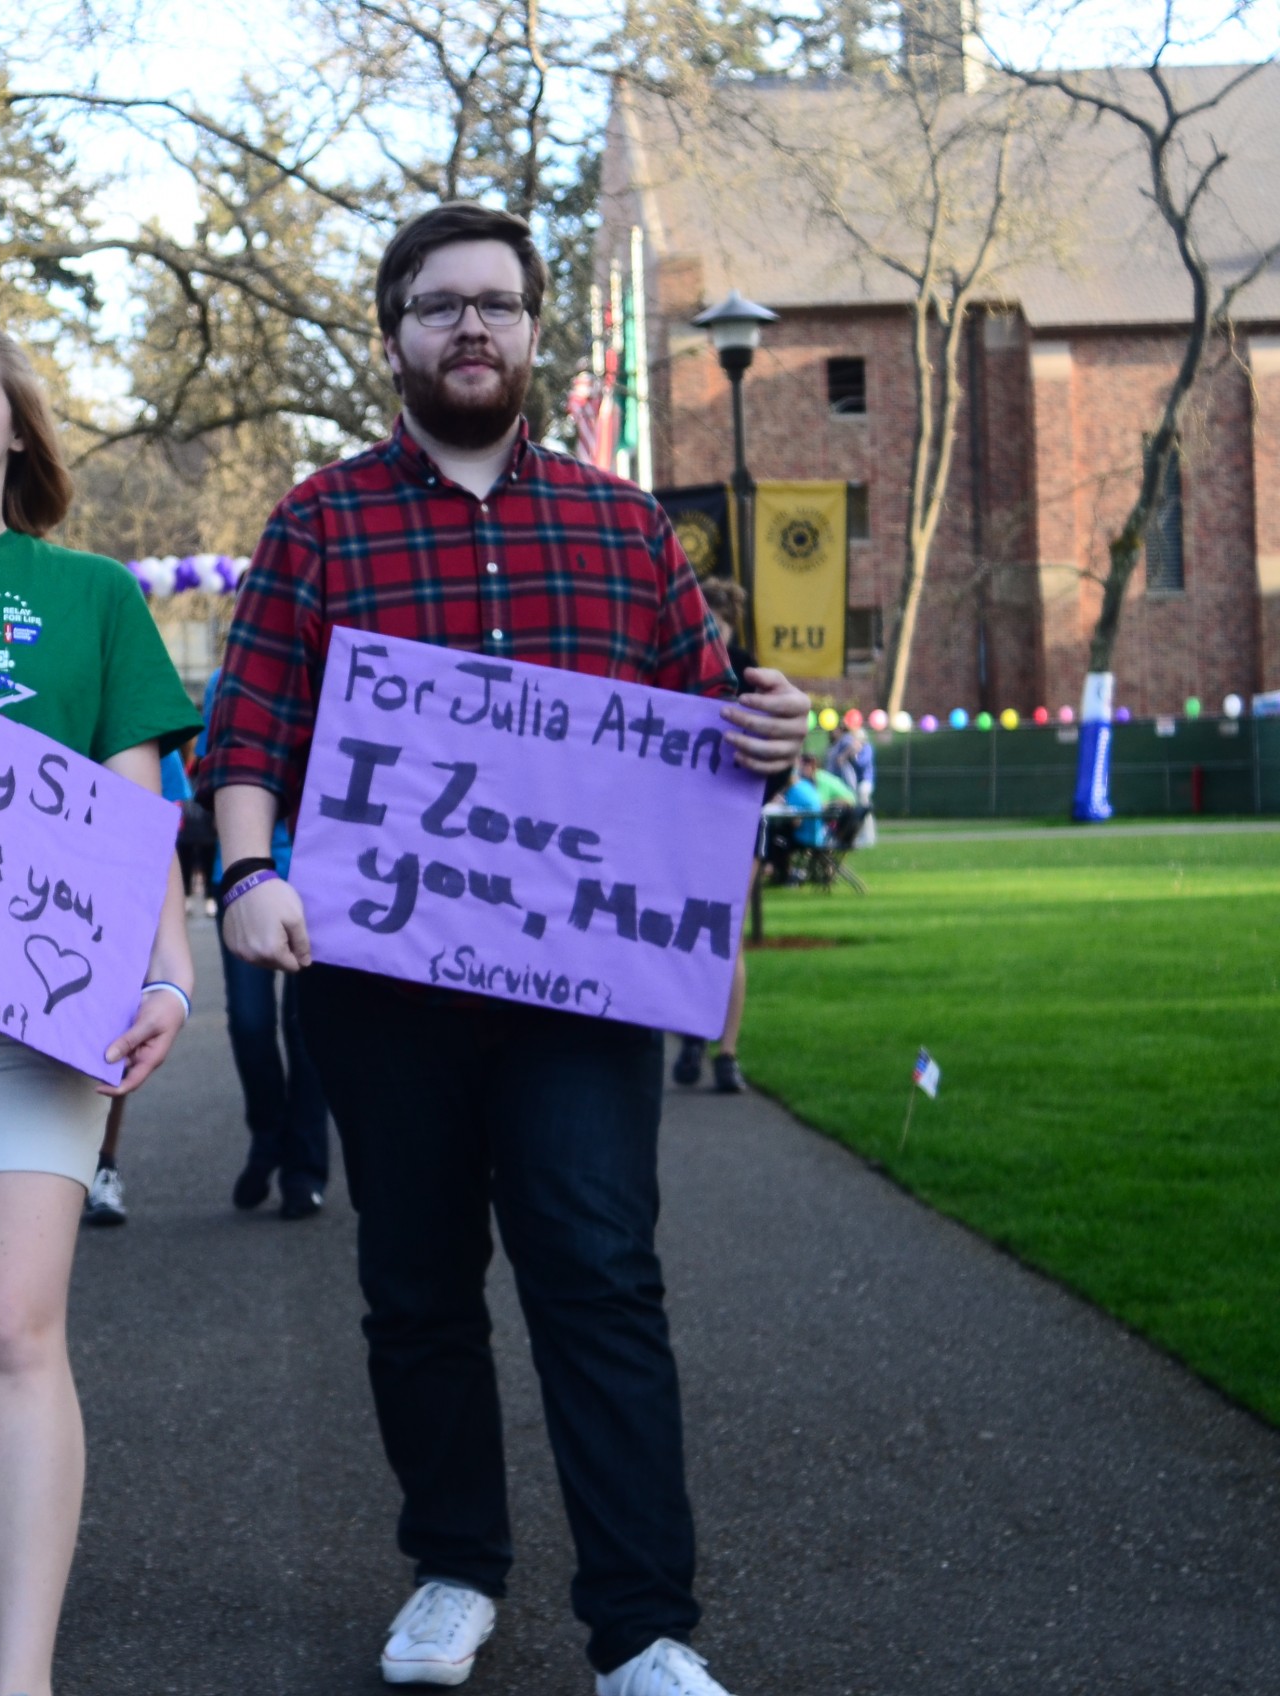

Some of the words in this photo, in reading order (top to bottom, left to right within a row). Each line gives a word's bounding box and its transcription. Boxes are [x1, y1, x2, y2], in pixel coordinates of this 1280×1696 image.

[3, 607, 31, 616] RELAY
[3, 614, 21, 622] FOR
[23, 615, 41, 624] LIFE
[772, 626, 825, 649] PLU
[344, 644, 435, 714] For
[449, 661, 569, 741] Julia
[319, 737, 403, 826] I
[8, 865, 103, 943] you,
